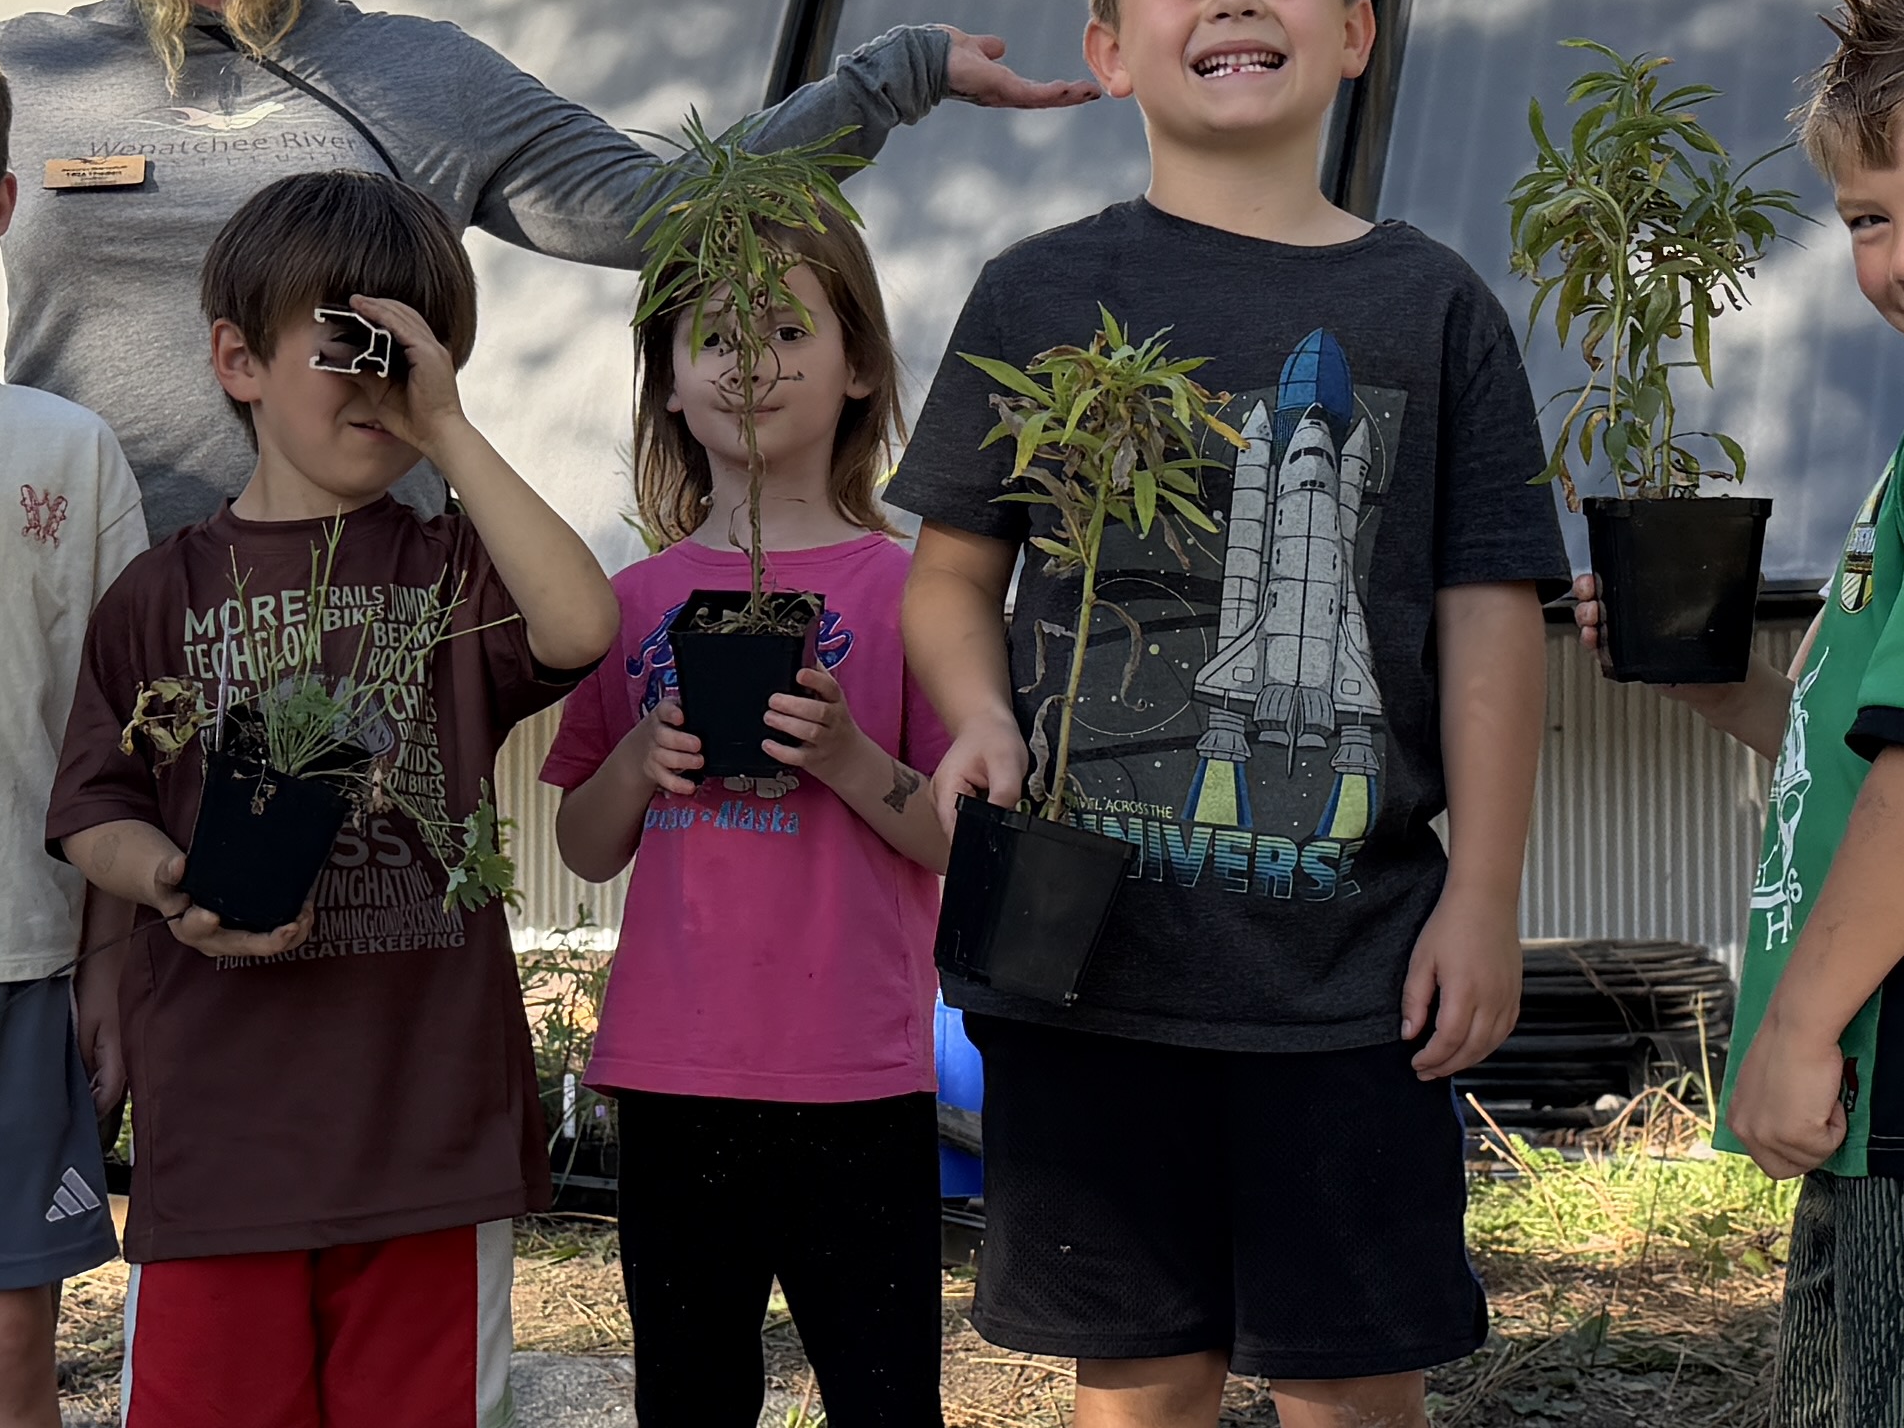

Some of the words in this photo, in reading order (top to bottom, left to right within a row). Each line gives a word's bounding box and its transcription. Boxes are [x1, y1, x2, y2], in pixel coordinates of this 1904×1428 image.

[90, 134, 268, 157] Wenatchee
[282, 131, 357, 151] River
[322, 604, 385, 632] BIKES
[394, 742, 444, 775] KIDS
[409, 773, 447, 798] BIKES
[713, 800, 800, 836] Alaska
[1105, 799, 1149, 816] ACROSS
[1150, 804, 1174, 819] THE
[1068, 813, 1366, 903] NIVERSE
[299, 932, 466, 961] GATEKEEPING
